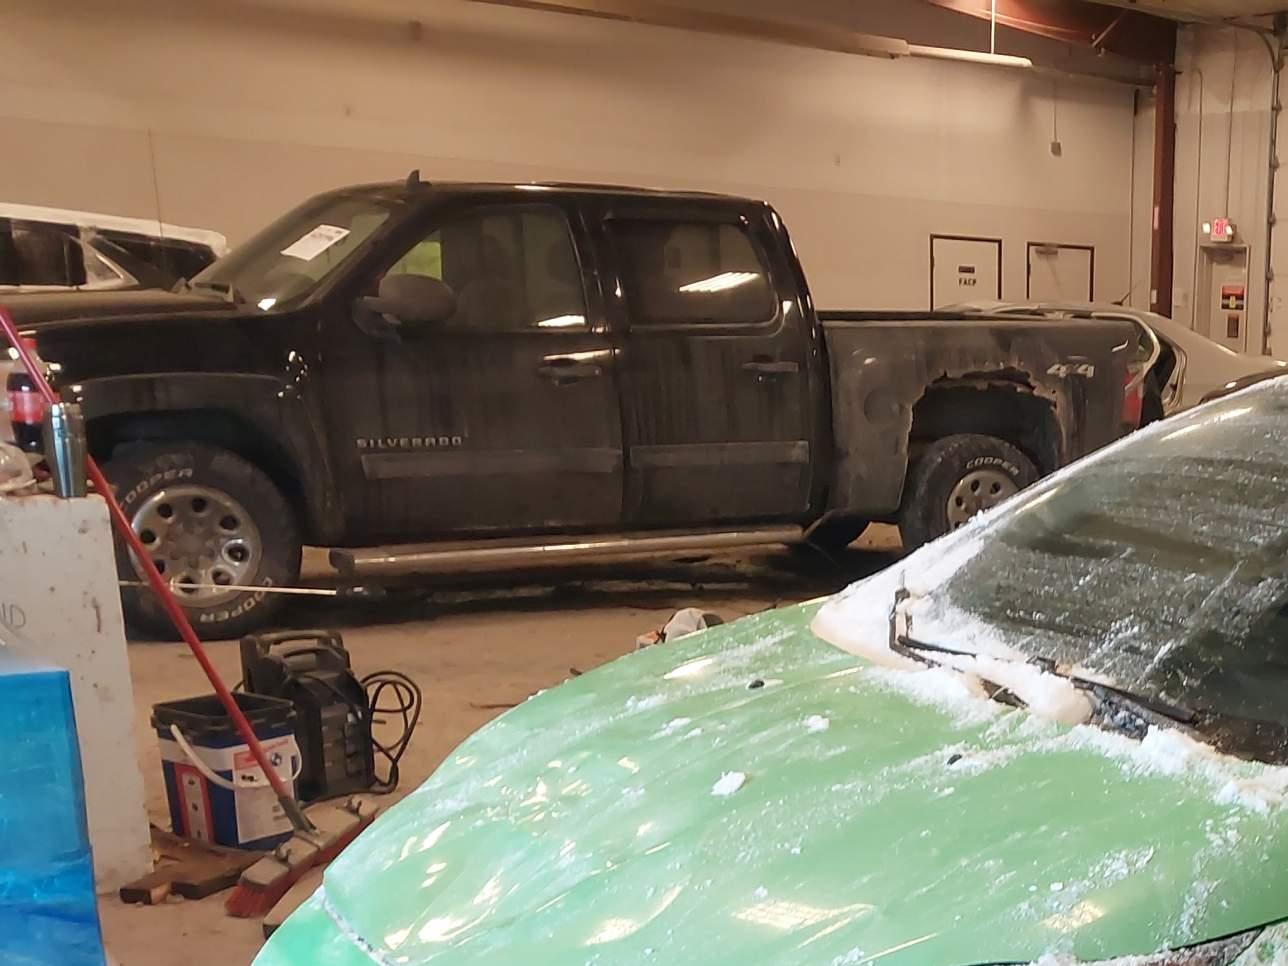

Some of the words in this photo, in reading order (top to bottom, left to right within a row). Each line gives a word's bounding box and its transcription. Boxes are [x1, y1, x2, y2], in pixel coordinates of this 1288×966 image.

[958, 277, 977, 287] FACP
[356, 435, 463, 449] SILVERADO
[966, 456, 1020, 476] COOPER
